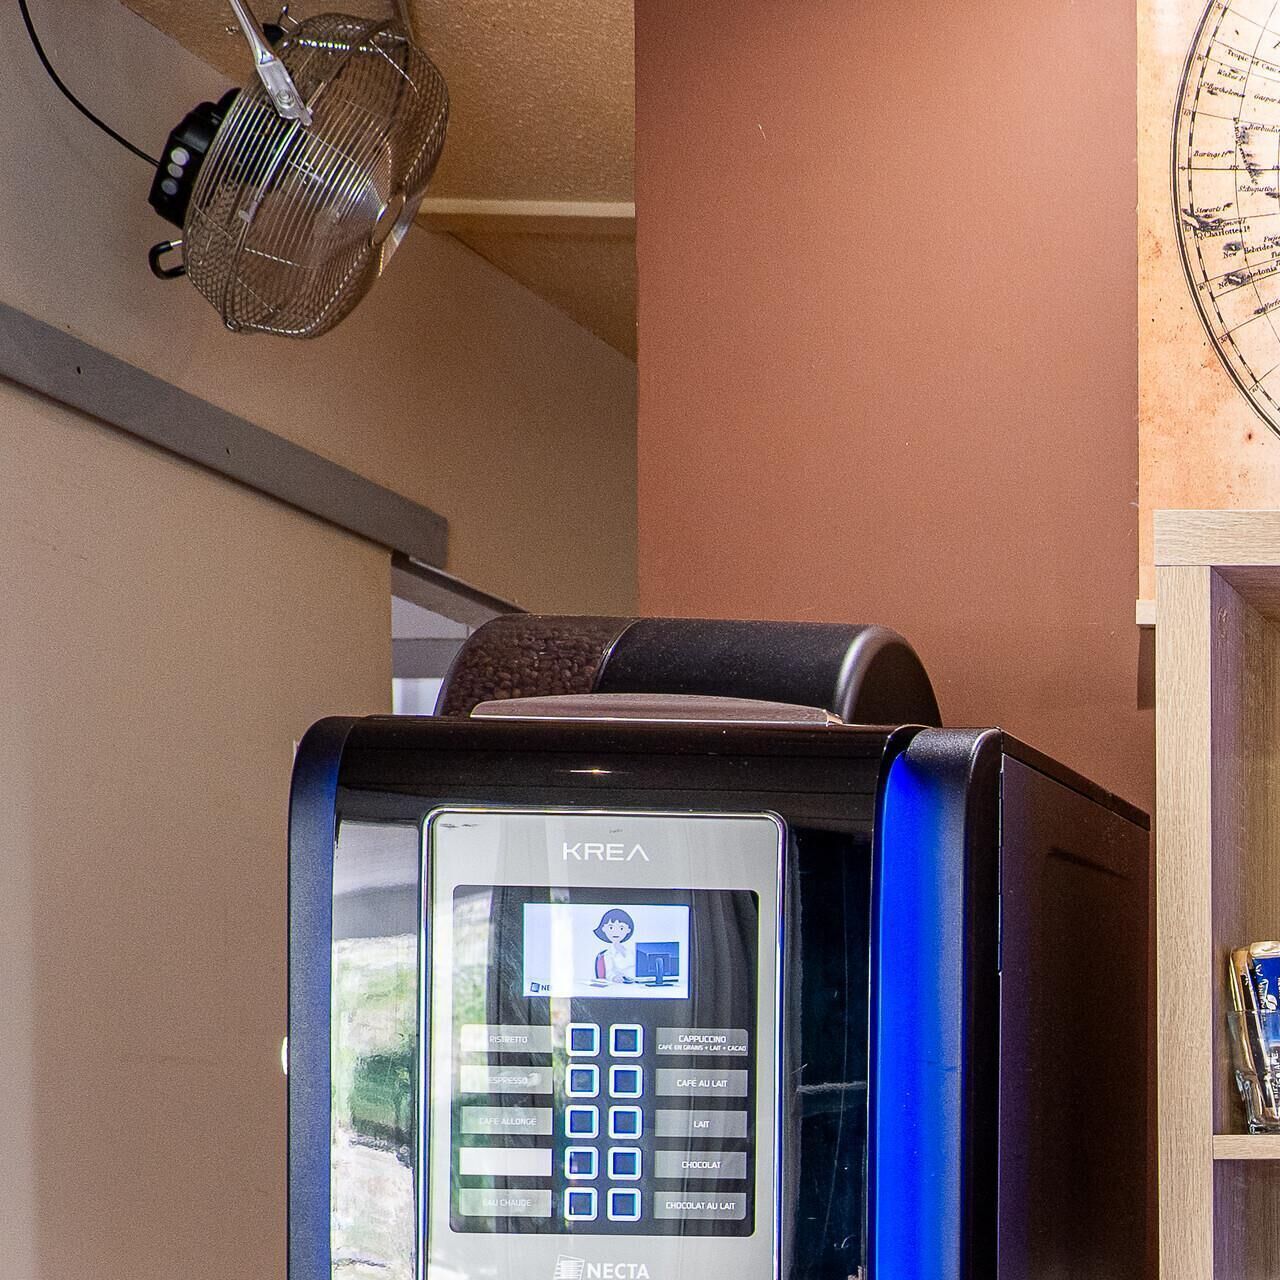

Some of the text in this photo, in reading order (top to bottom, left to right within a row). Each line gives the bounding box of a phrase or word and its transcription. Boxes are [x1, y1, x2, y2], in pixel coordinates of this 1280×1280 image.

[562, 841, 650, 863] KREA
[678, 1034, 727, 1044] CAPPUCCINO
[698, 1079, 711, 1088] AU
[711, 1079, 728, 1088] LAIT
[693, 1120, 711, 1129] LAIT
[681, 1160, 722, 1170] CHOCOLAT
[665, 1201, 736, 1211] CHOCOLAT AU LAIT
[586, 1261, 651, 1280] NECTA
